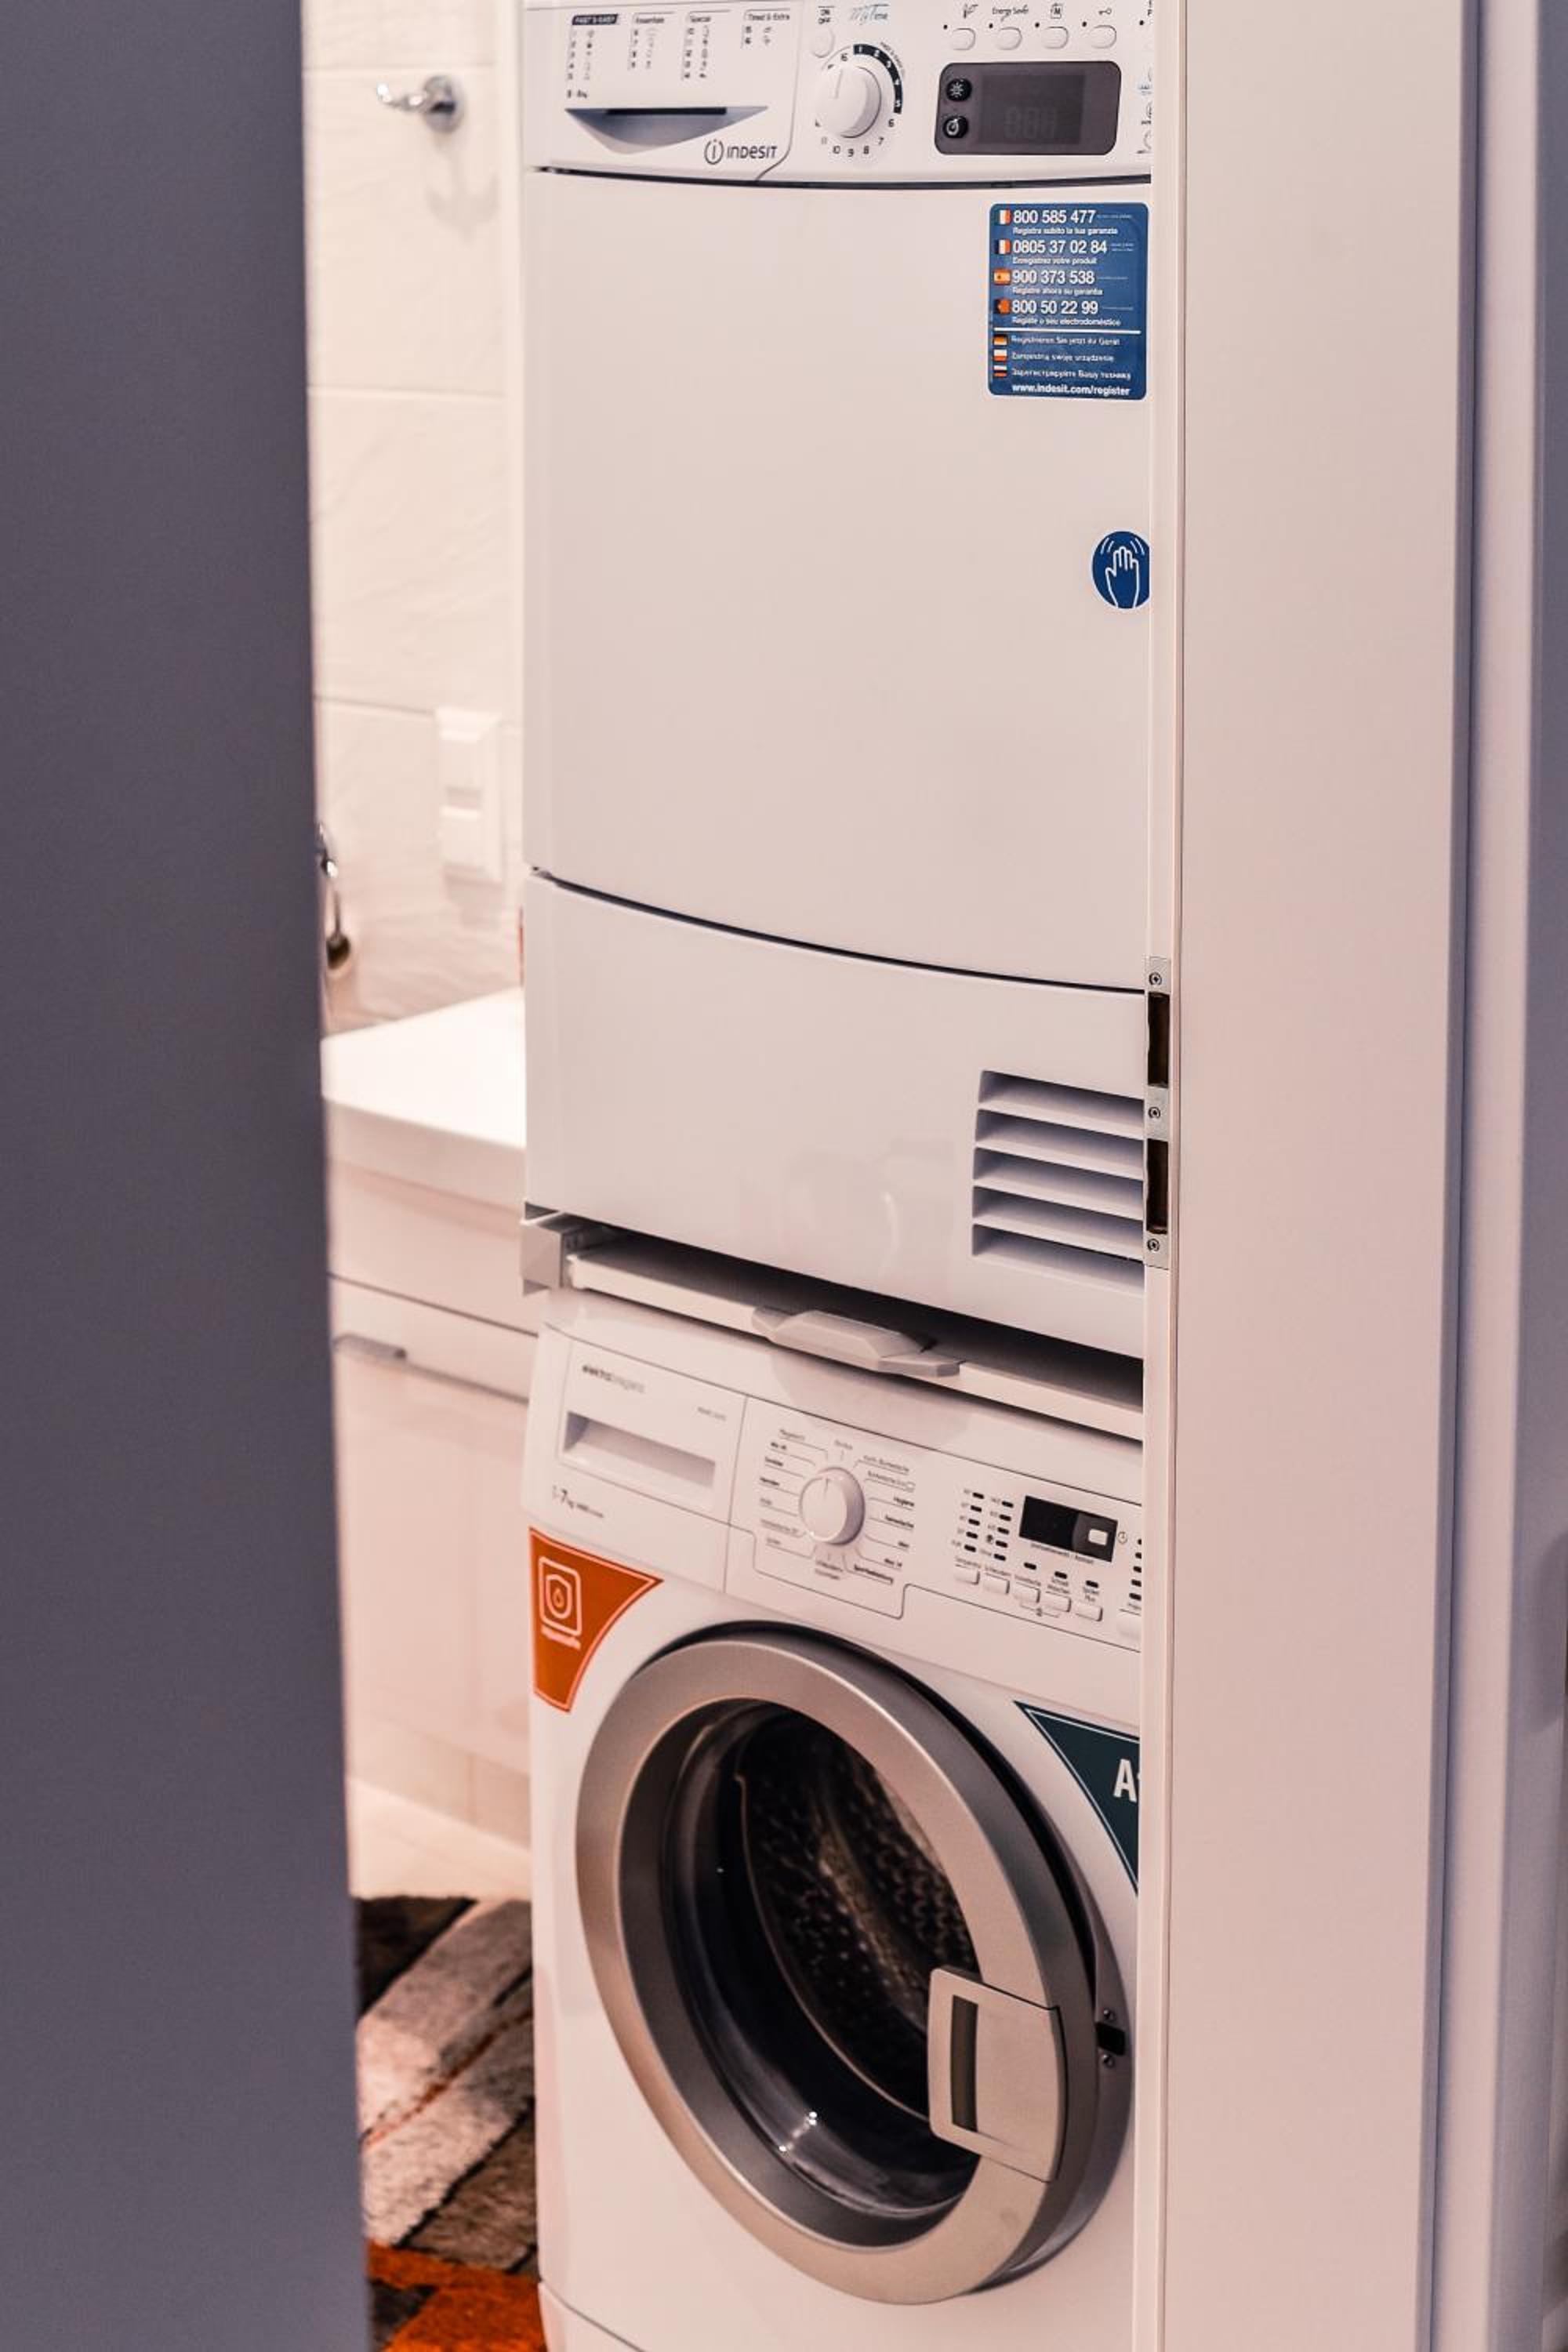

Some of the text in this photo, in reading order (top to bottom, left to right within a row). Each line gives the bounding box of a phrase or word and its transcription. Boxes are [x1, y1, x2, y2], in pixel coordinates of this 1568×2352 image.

[1013, 209, 1038, 223] 800
[1042, 209, 1067, 223] 585
[1070, 209, 1096, 223] 477
[1050, 239, 1066, 253] 37
[1069, 239, 1087, 253] 02
[1091, 240, 1108, 254] 84
[1012, 270, 1095, 284] 900 373 538
[1012, 300, 1037, 314] 800
[1040, 300, 1057, 314] 50
[1061, 300, 1077, 314] 22
[1081, 300, 1098, 314] 99
[1011, 383, 1131, 396] www.indesit.com/register
[1113, 1759, 1140, 1803] A
